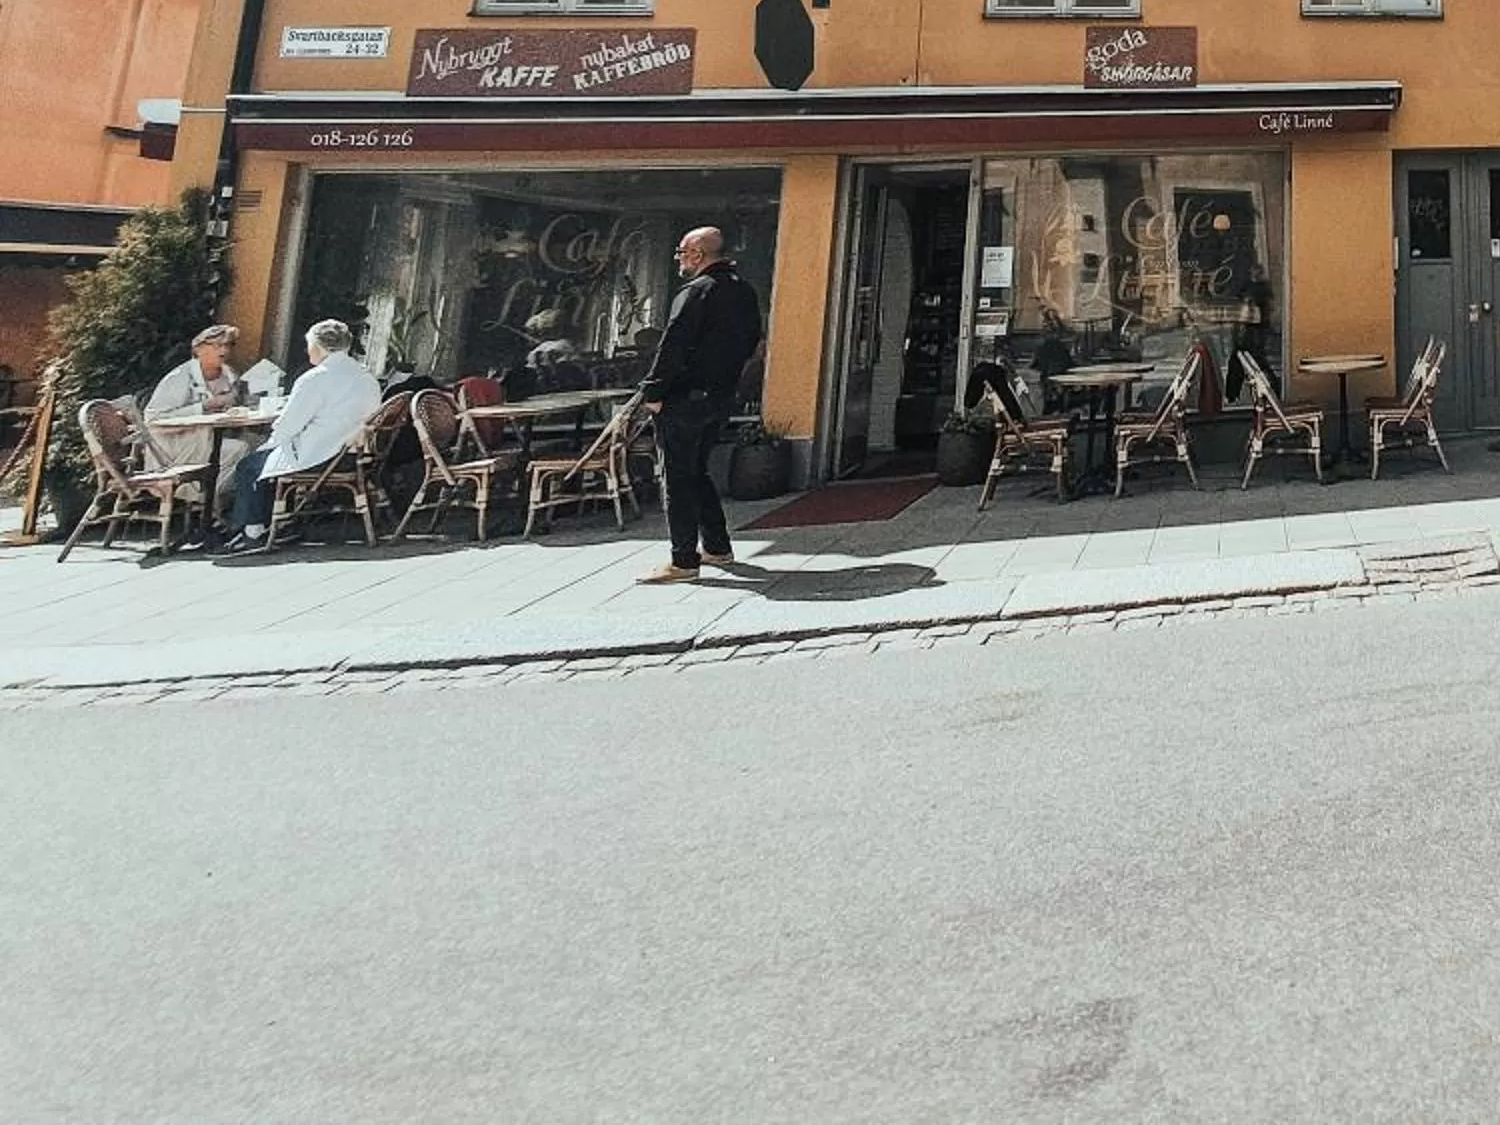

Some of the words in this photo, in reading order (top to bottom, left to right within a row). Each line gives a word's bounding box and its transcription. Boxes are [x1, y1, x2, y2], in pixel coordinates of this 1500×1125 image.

[416, 36, 513, 80] Nybryggt
[572, 42, 692, 91] KAFFEBRÖD
[580, 32, 656, 70] nybakat
[1087, 28, 1148, 71] goda
[479, 65, 560, 88] KAFFE
[310, 129, 380, 146] 018-126
[383, 127, 413, 146] 126
[1259, 112, 1291, 134] Café
[1294, 112, 1334, 129] Linné
